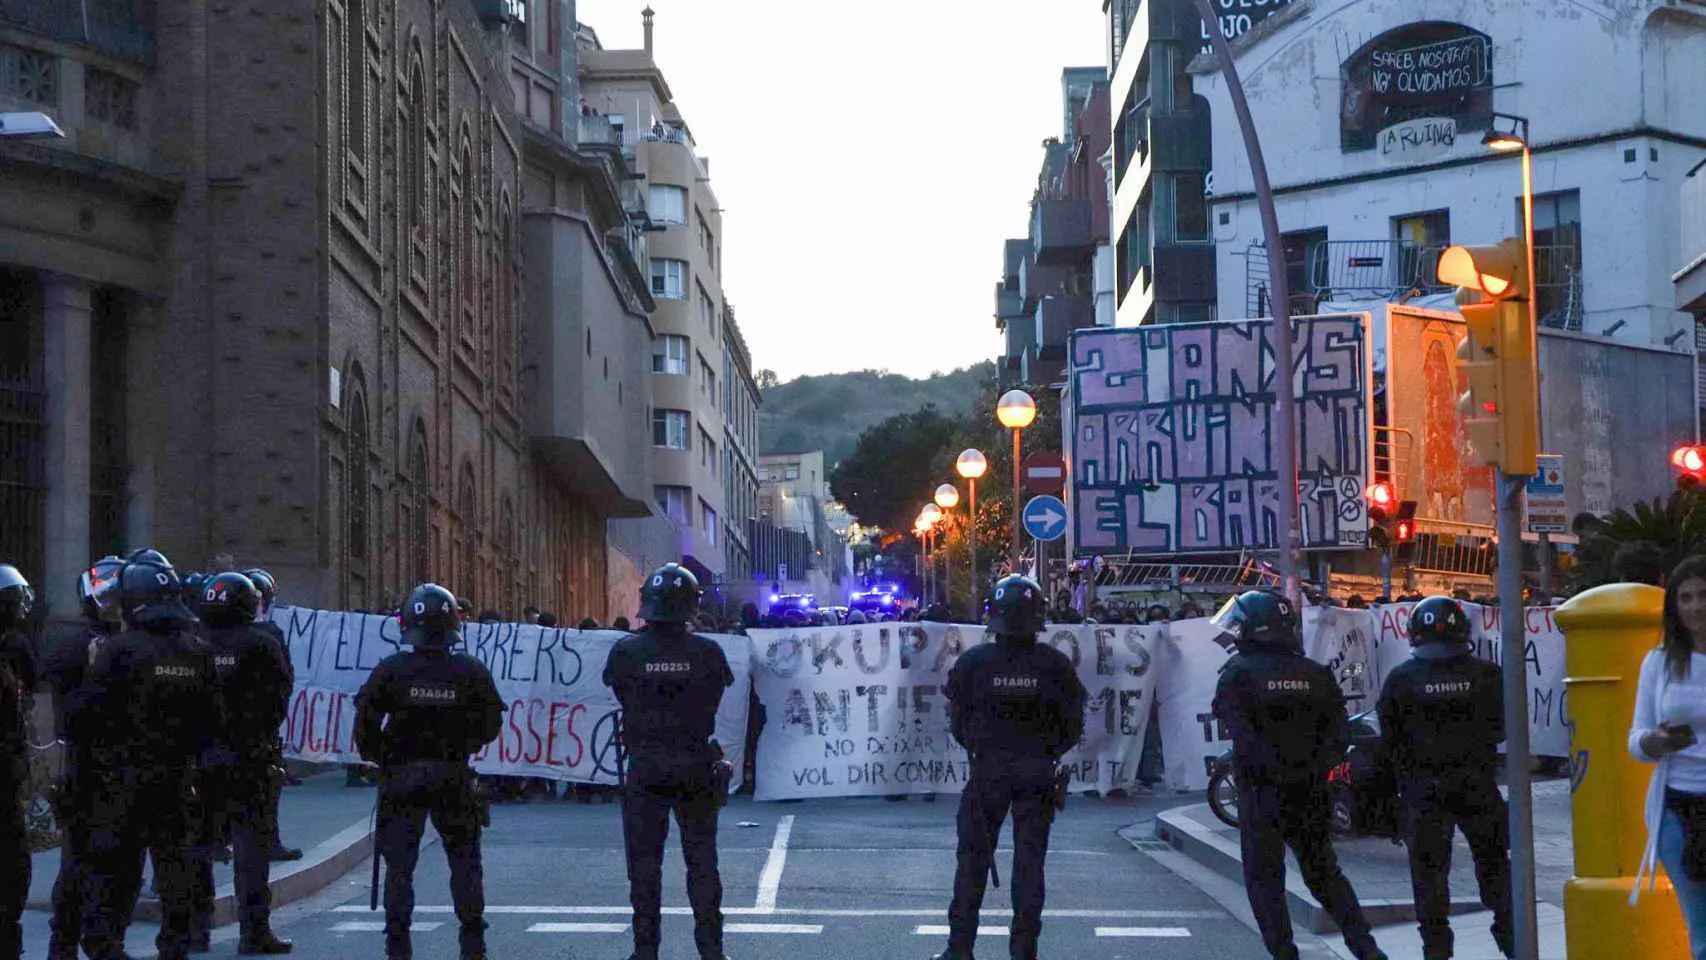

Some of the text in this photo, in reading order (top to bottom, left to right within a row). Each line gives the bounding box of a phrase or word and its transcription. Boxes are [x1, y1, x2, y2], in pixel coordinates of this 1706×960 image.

[1076, 484, 1173, 549] EL
[656, 574, 683, 587] D 4
[414, 602, 425, 615] D
[1423, 612, 1435, 625] D
[452, 623, 583, 686] ARRERS
[824, 739, 855, 759] NO
[792, 764, 834, 787] VOL
[847, 761, 888, 785] DIR
